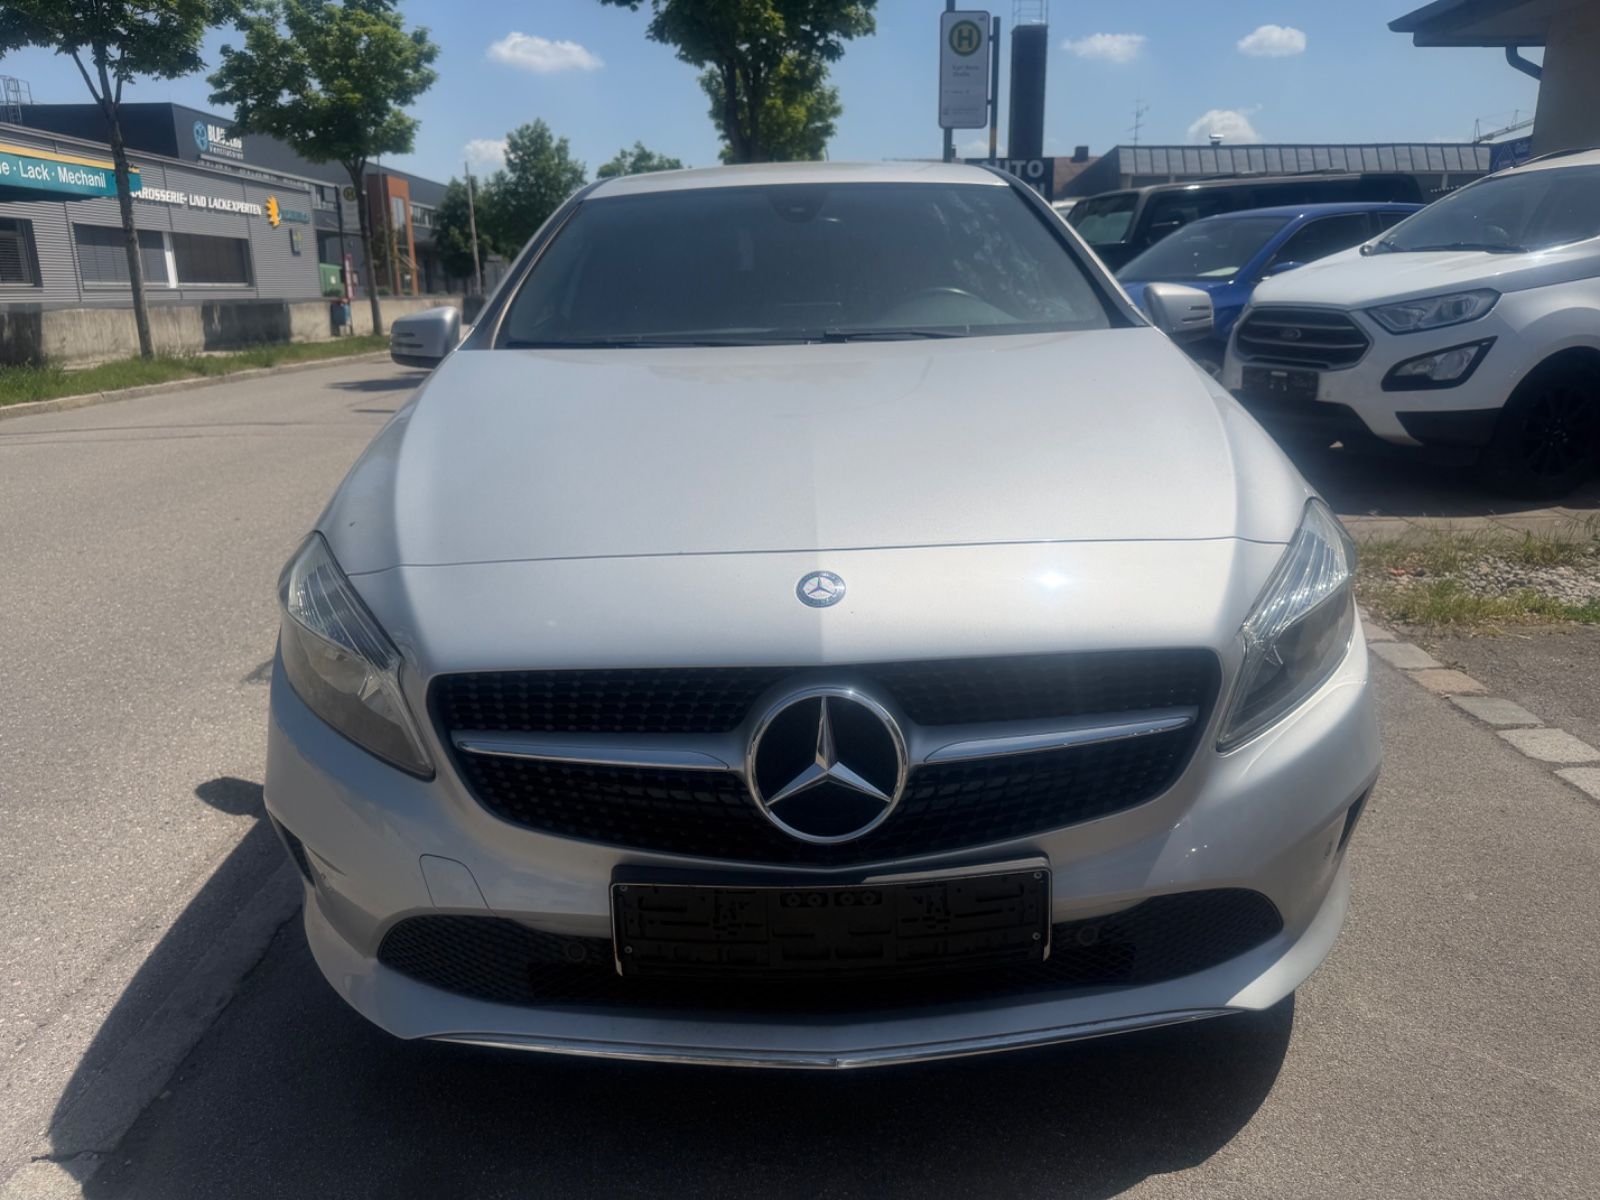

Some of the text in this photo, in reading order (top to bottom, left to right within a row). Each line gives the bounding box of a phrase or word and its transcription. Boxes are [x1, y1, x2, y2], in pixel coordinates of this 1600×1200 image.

[957, 28, 973, 49] H
[0, 161, 10, 176] e
[19, 160, 50, 181] Lack
[981, 159, 1044, 178] UTO
[189, 193, 207, 208] UND
[207, 196, 262, 216] LACKEXPERTEN
